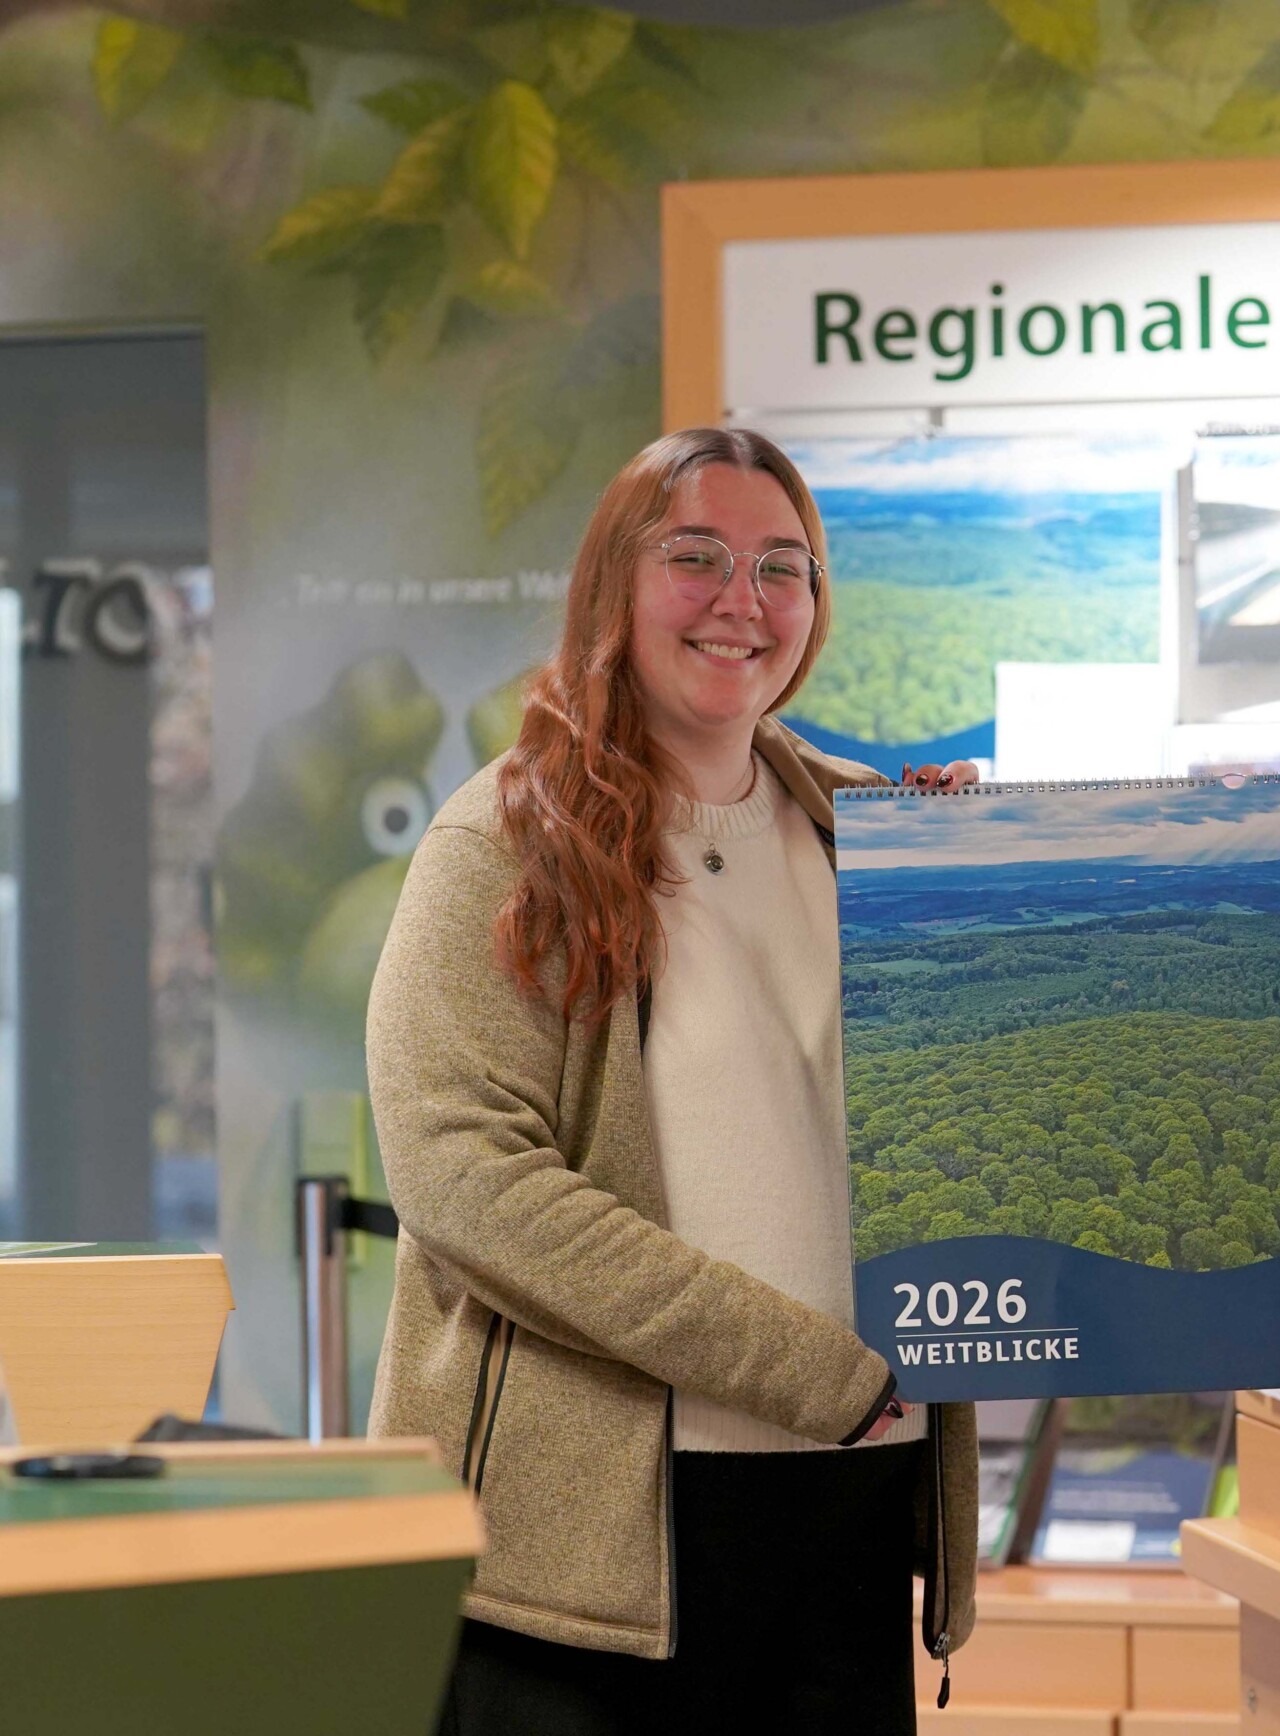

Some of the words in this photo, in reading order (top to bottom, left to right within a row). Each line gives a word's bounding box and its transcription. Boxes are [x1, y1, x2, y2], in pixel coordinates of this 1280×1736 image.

[814, 273, 1272, 382] Regionale
[893, 1278, 1027, 1328] 2026
[897, 1337, 1080, 1366] WEITBLICKE
